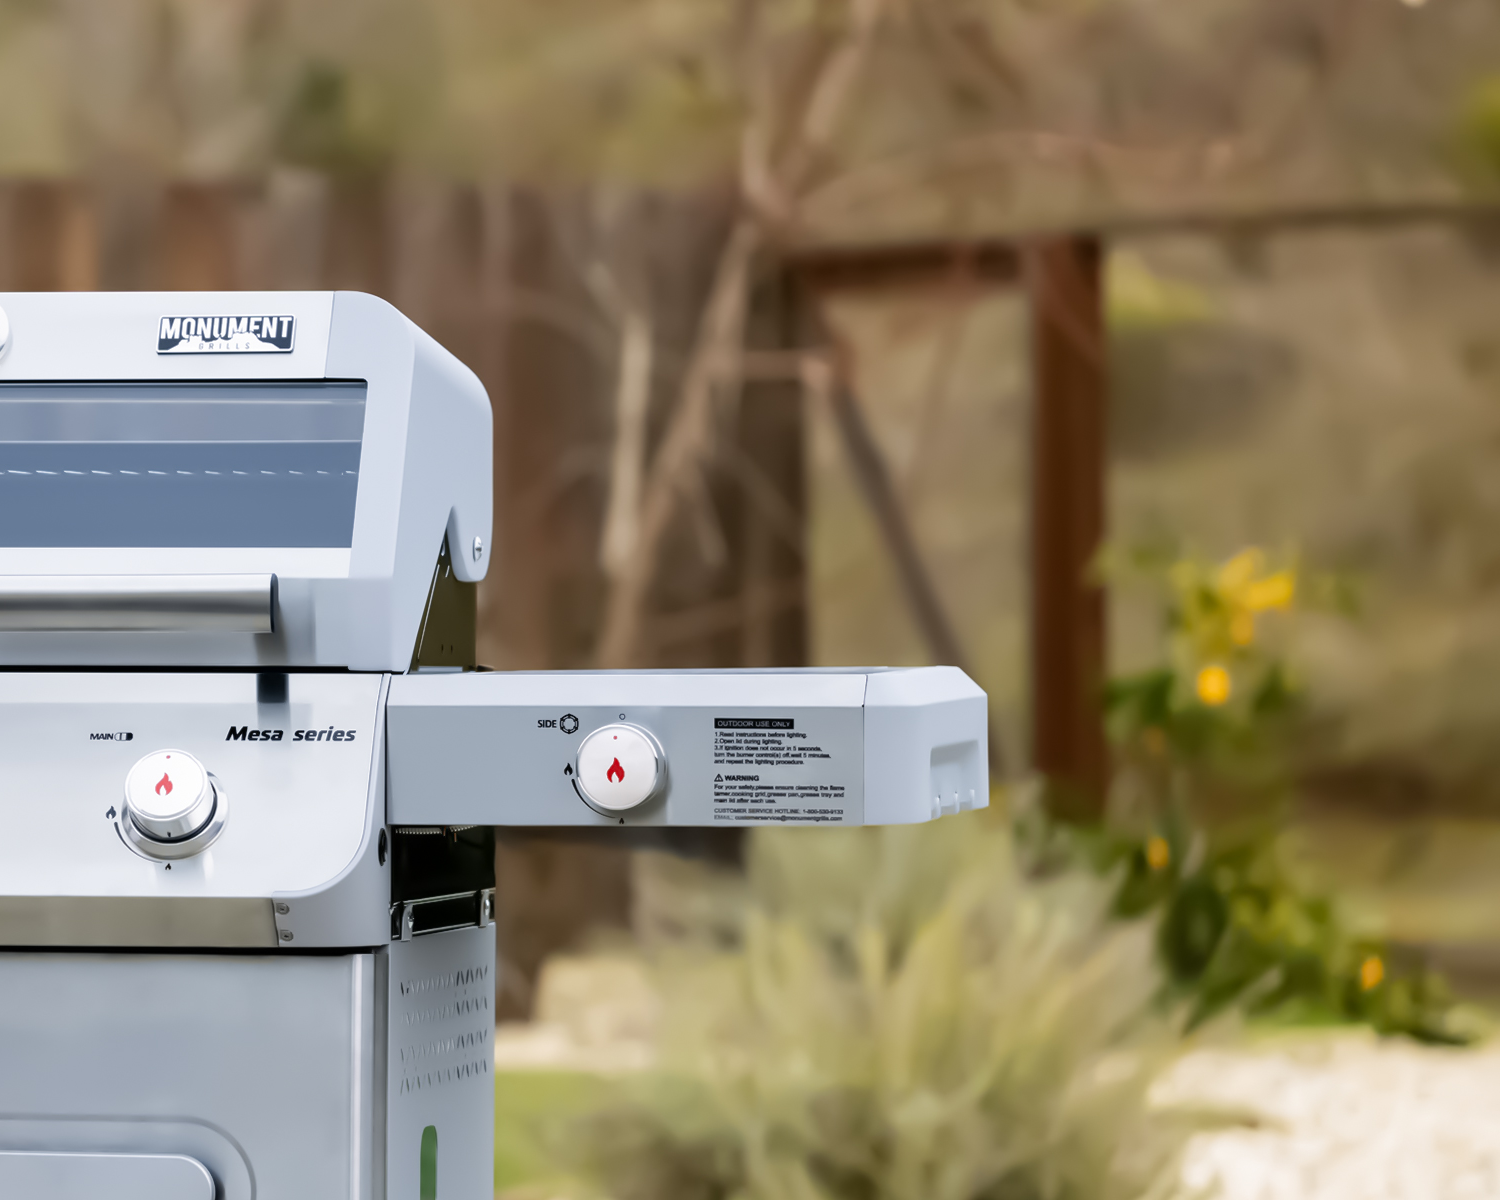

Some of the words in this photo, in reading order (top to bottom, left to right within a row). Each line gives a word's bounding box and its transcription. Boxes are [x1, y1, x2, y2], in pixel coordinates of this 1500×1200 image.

[160, 316, 293, 340] MONUMENT
[198, 342, 251, 350] GRILLS
[537, 719, 557, 728] SIDE
[225, 726, 284, 741] Mesa
[292, 726, 356, 741] series
[724, 774, 760, 782] WARNING
